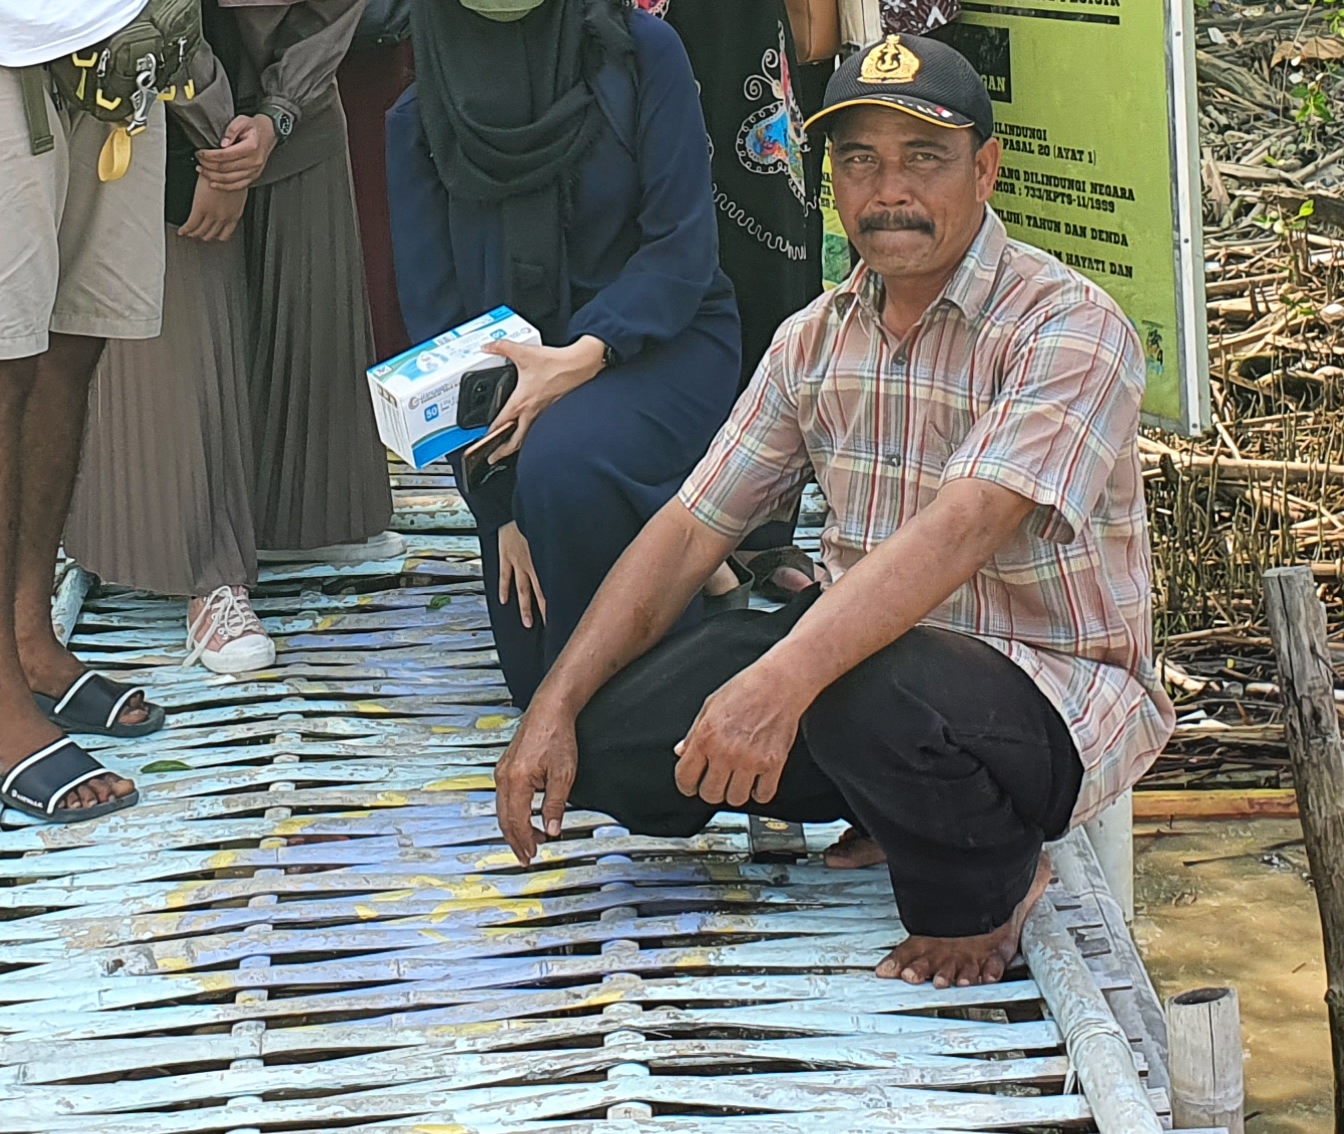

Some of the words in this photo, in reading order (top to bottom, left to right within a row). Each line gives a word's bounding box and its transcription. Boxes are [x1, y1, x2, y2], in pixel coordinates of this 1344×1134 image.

[994, 122, 1047, 141] ILINDUNGI
[1002, 137, 1035, 155] PASAL
[1037, 143, 1050, 157] 20
[1053, 144, 1084, 163] (AYAT
[994, 180, 1016, 196] MOR
[1023, 170, 1086, 194] DILINDUNGI
[1090, 182, 1135, 201] NEGARA
[1025, 215, 1061, 233] TAHUN
[1064, 223, 1087, 239] DAN
[1090, 228, 1129, 247] DENDA
[1065, 252, 1105, 273] HAYATI
[1109, 262, 1133, 278] DAN
